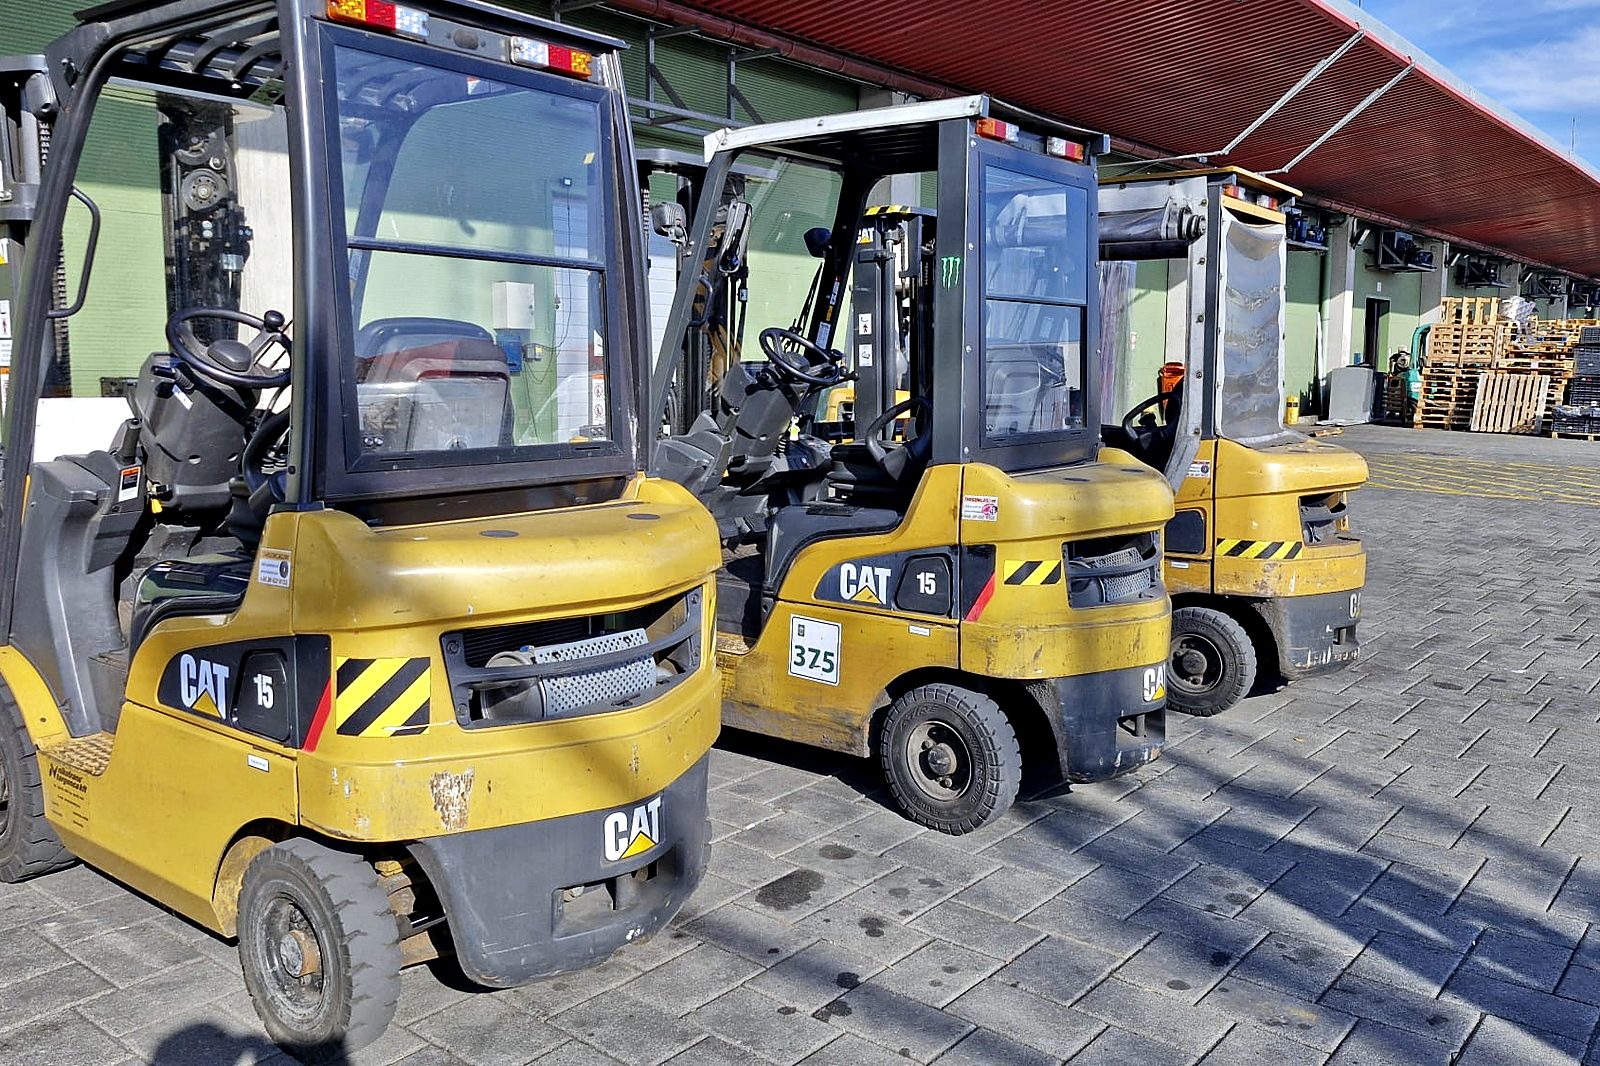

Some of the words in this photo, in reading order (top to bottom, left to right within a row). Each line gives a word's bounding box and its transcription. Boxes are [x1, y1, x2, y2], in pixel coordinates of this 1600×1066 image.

[839, 562, 892, 605] CAT
[916, 572, 936, 594] 15
[793, 644, 835, 673] 375
[180, 653, 230, 720] CAT
[253, 673, 274, 709] 15
[604, 796, 662, 861] CAT
